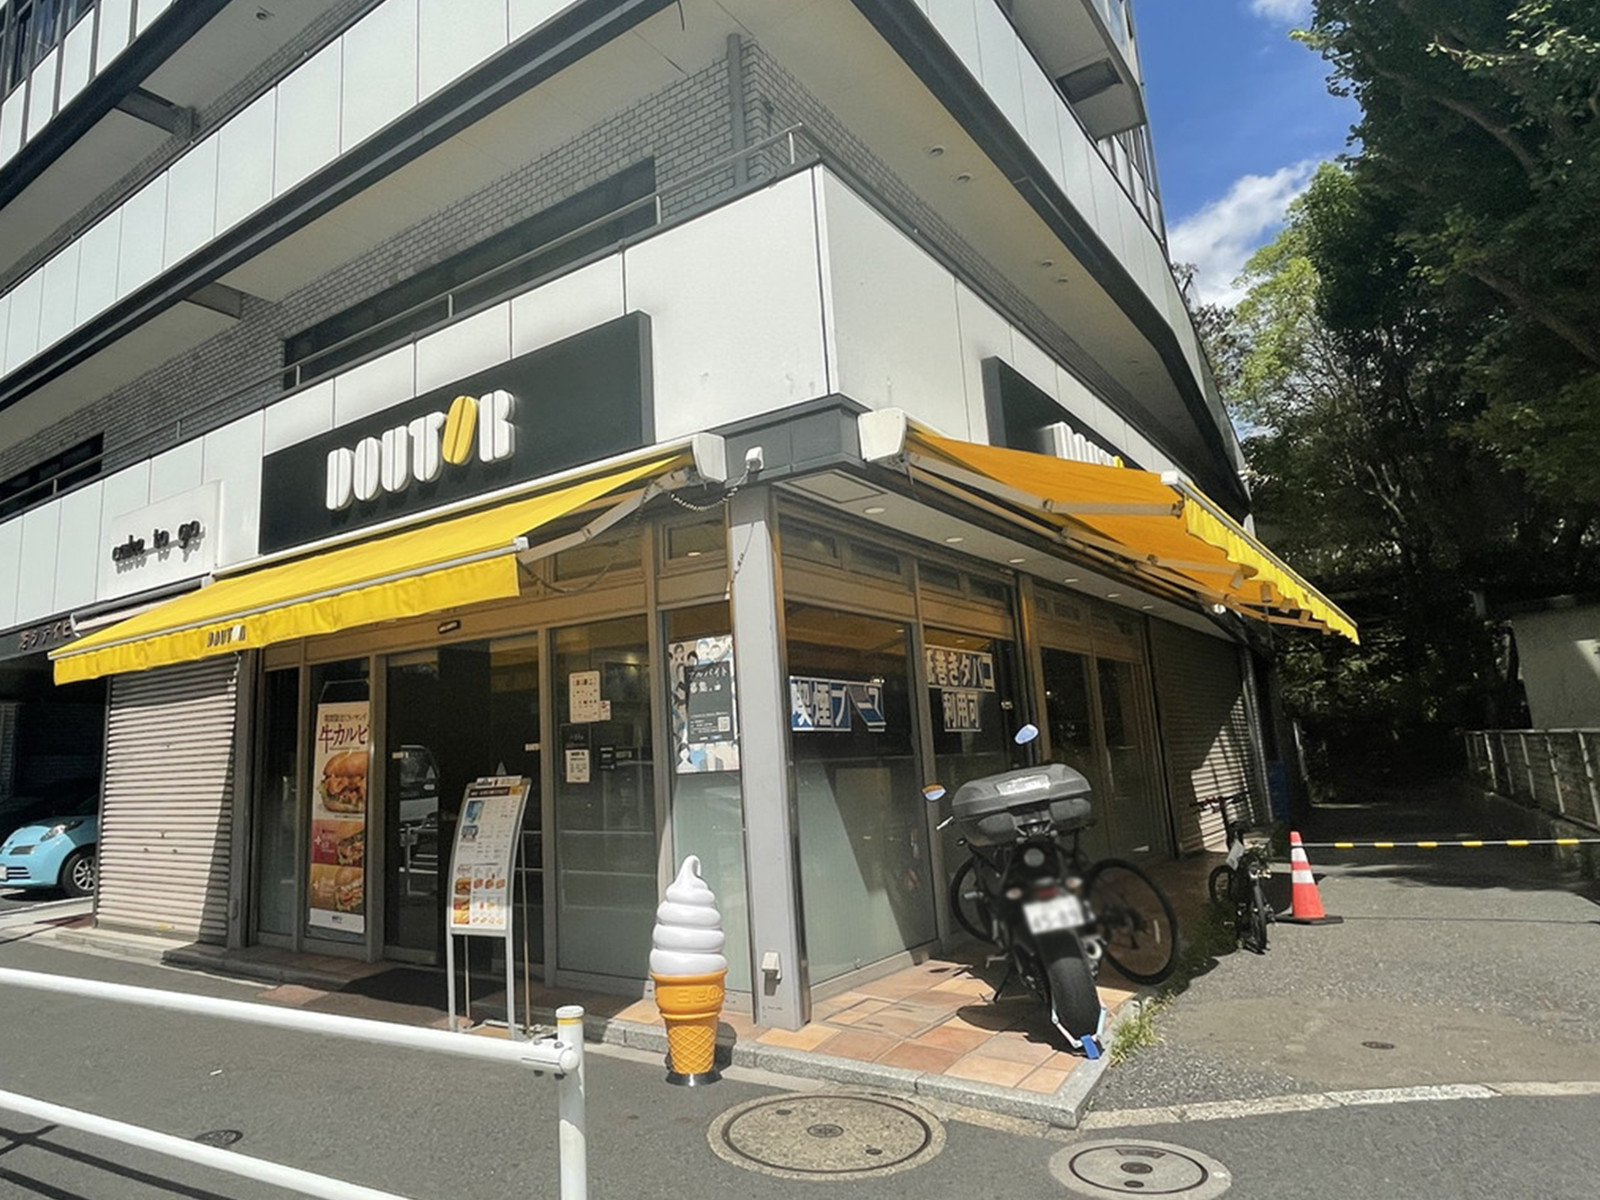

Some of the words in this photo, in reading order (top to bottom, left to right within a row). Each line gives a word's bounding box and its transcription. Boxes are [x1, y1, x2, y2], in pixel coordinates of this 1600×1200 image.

[326, 389, 515, 511] DOUTOR
[944, 692, 980, 729] 利用可
